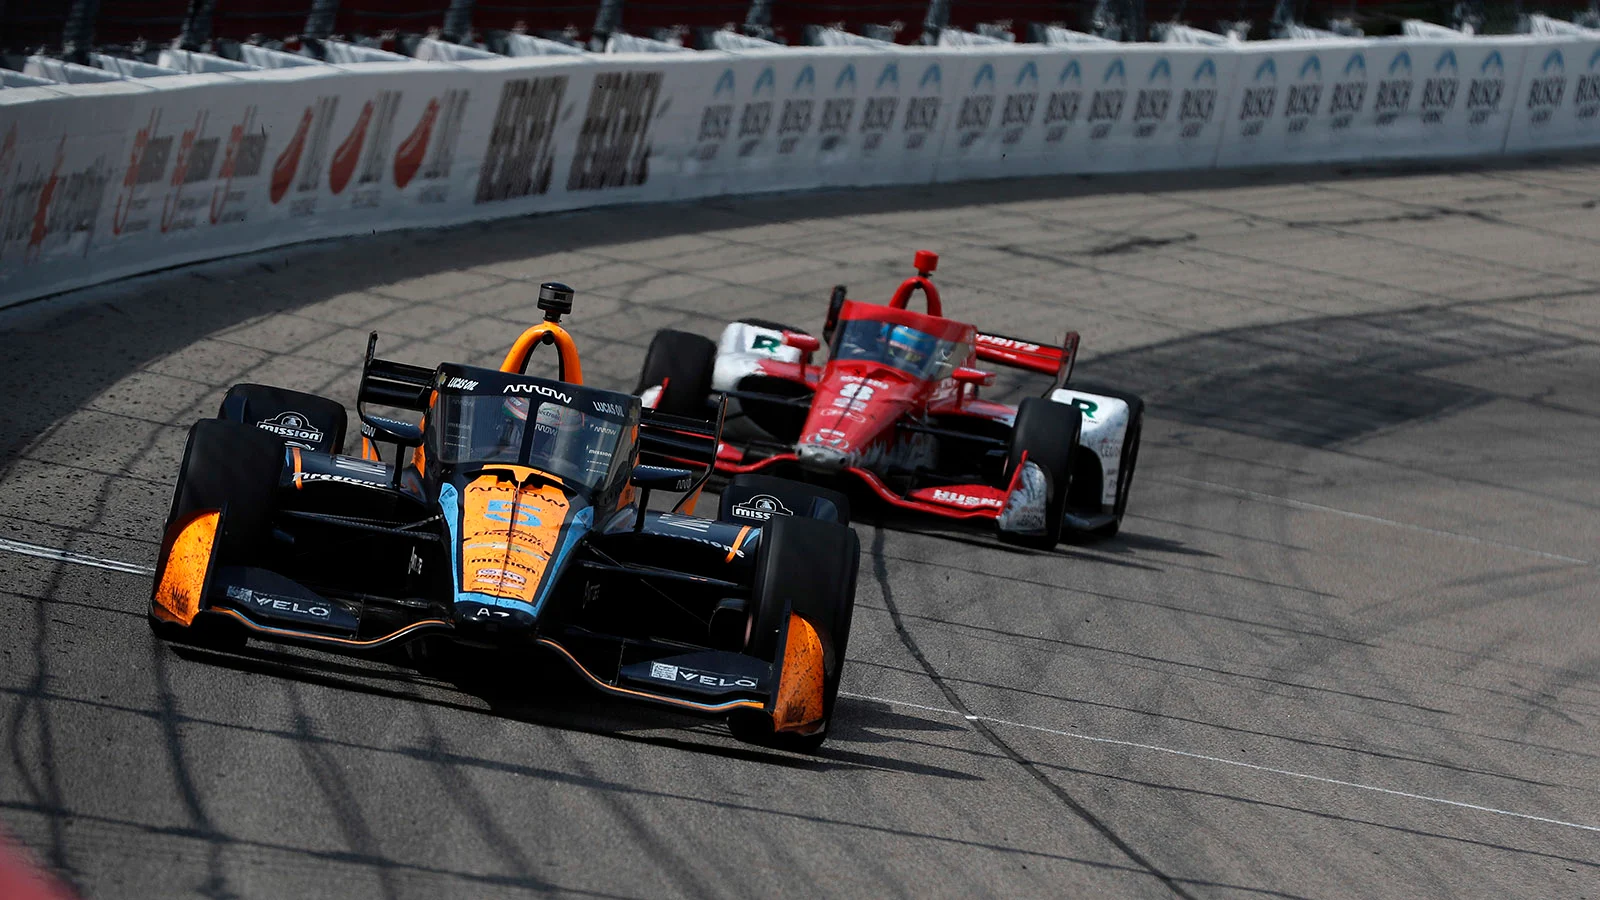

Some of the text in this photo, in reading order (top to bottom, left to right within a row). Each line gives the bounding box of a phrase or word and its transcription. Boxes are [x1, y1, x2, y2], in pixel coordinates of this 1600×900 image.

[752, 335, 781, 353] R
[447, 377, 479, 391] LUCAS OIL
[840, 383, 874, 400] 8
[503, 384, 572, 404] ARROW
[593, 401, 625, 417] LUCAS OIL
[1071, 398, 1098, 418] R
[260, 424, 319, 441] mission
[484, 500, 542, 527] 5
[736, 508, 771, 520] miss
[254, 594, 329, 616] VELO
[680, 670, 756, 687] VELO
